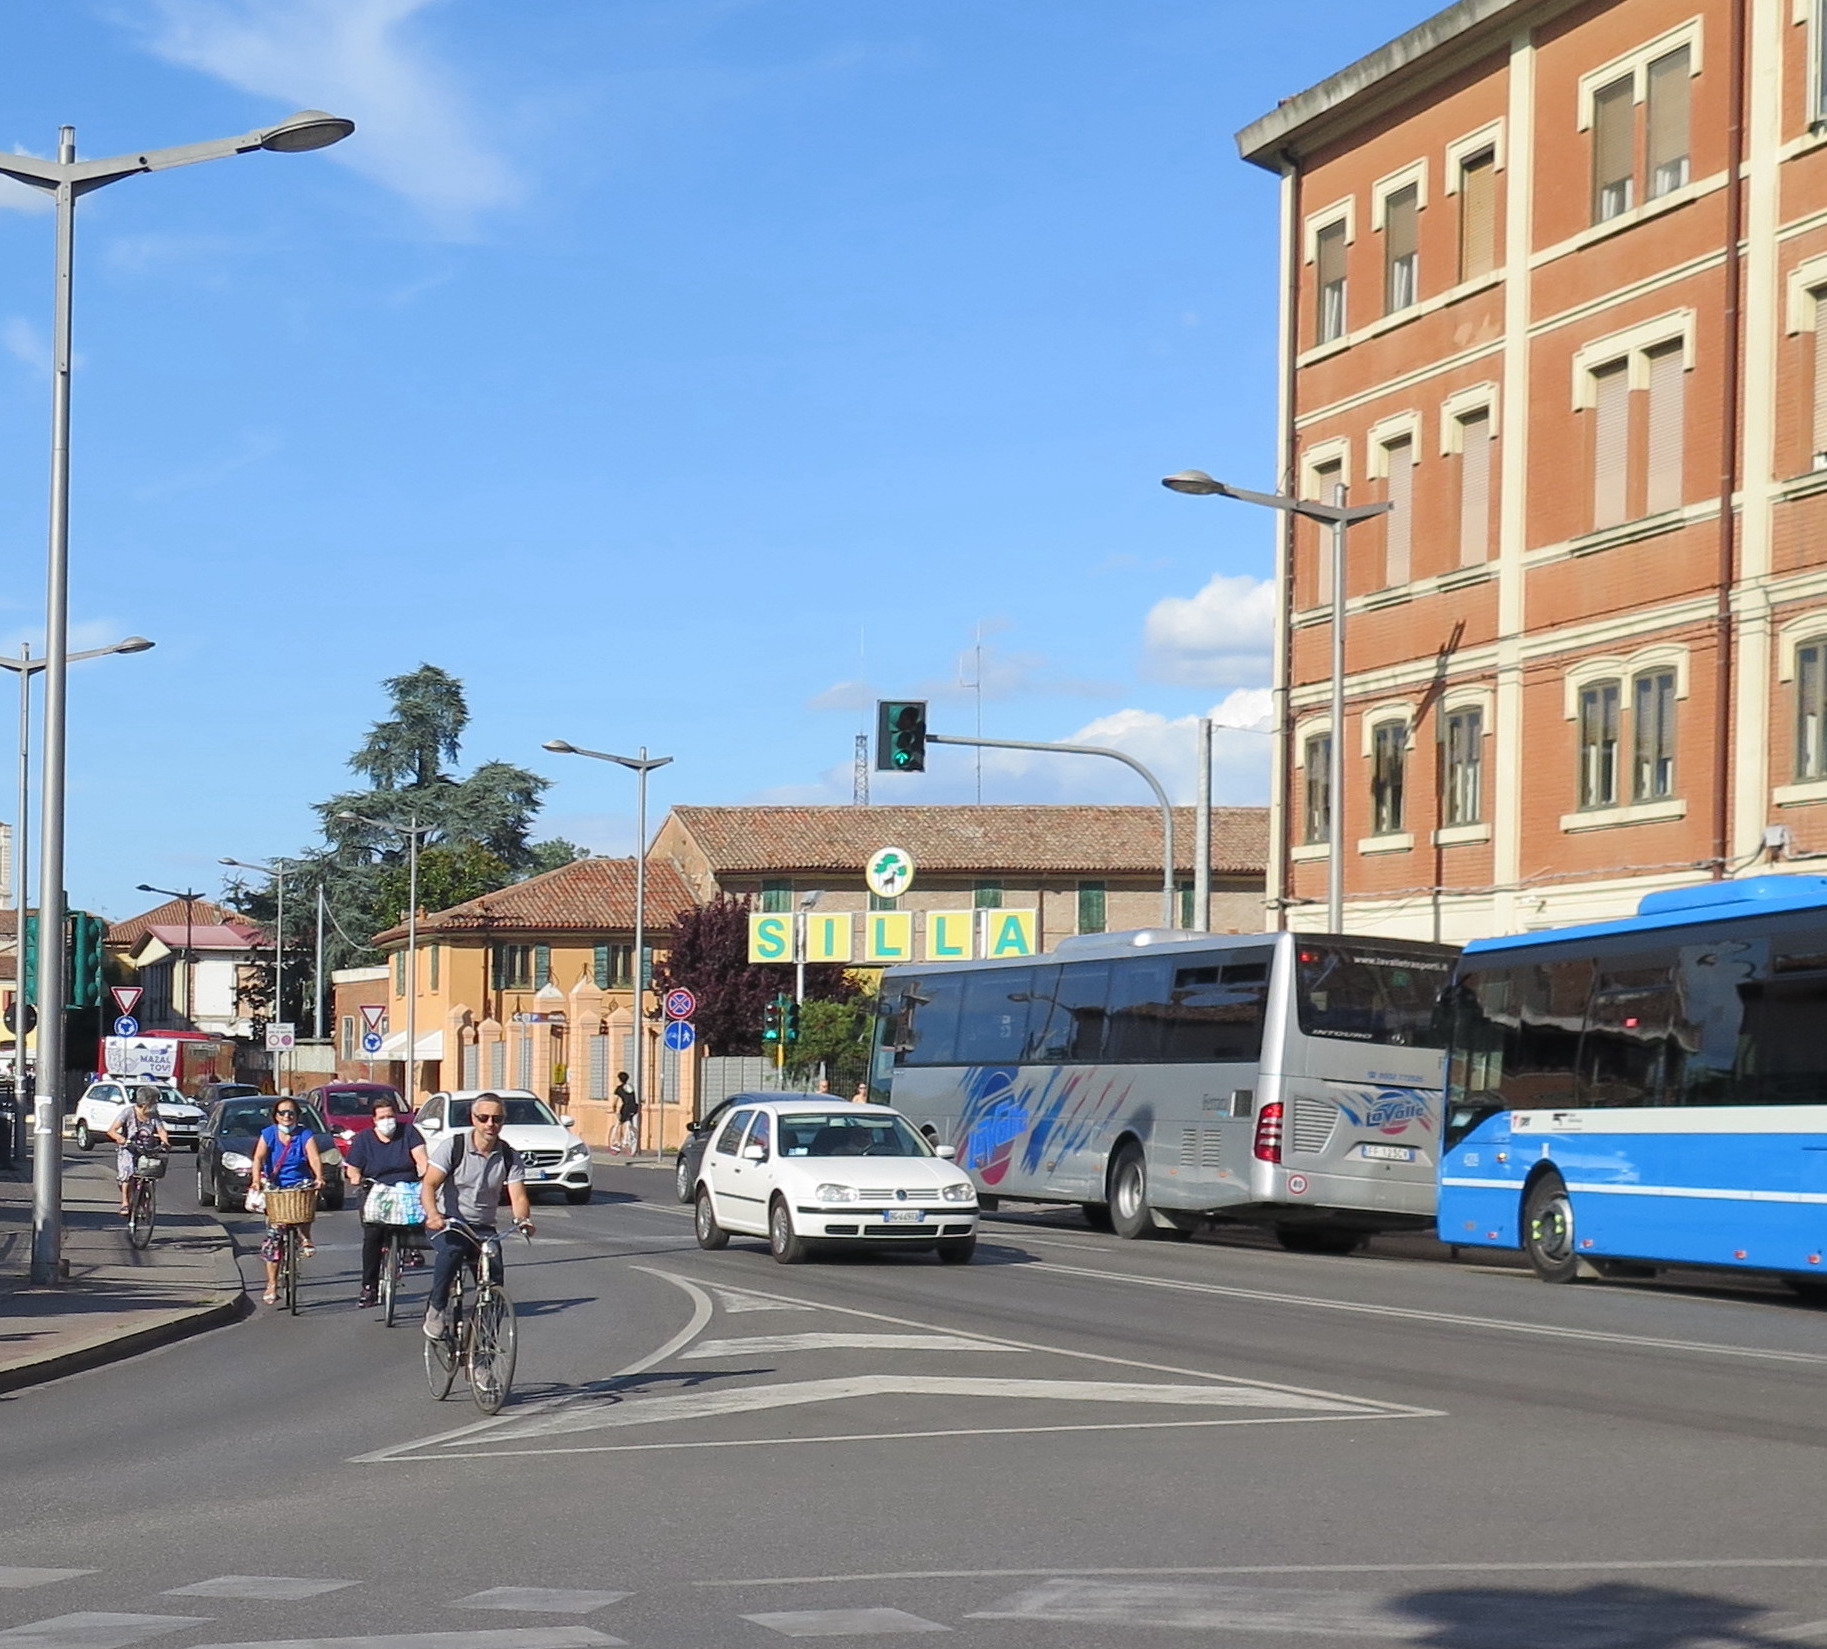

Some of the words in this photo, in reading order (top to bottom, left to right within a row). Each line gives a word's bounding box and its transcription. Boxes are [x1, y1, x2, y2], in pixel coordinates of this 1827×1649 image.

[757, 915, 1030, 958] SILLA
[1312, 1029, 1372, 1040] INTOURO
[140, 1054, 171, 1064] MAZAL
[1366, 1103, 1424, 1127] LaValle
